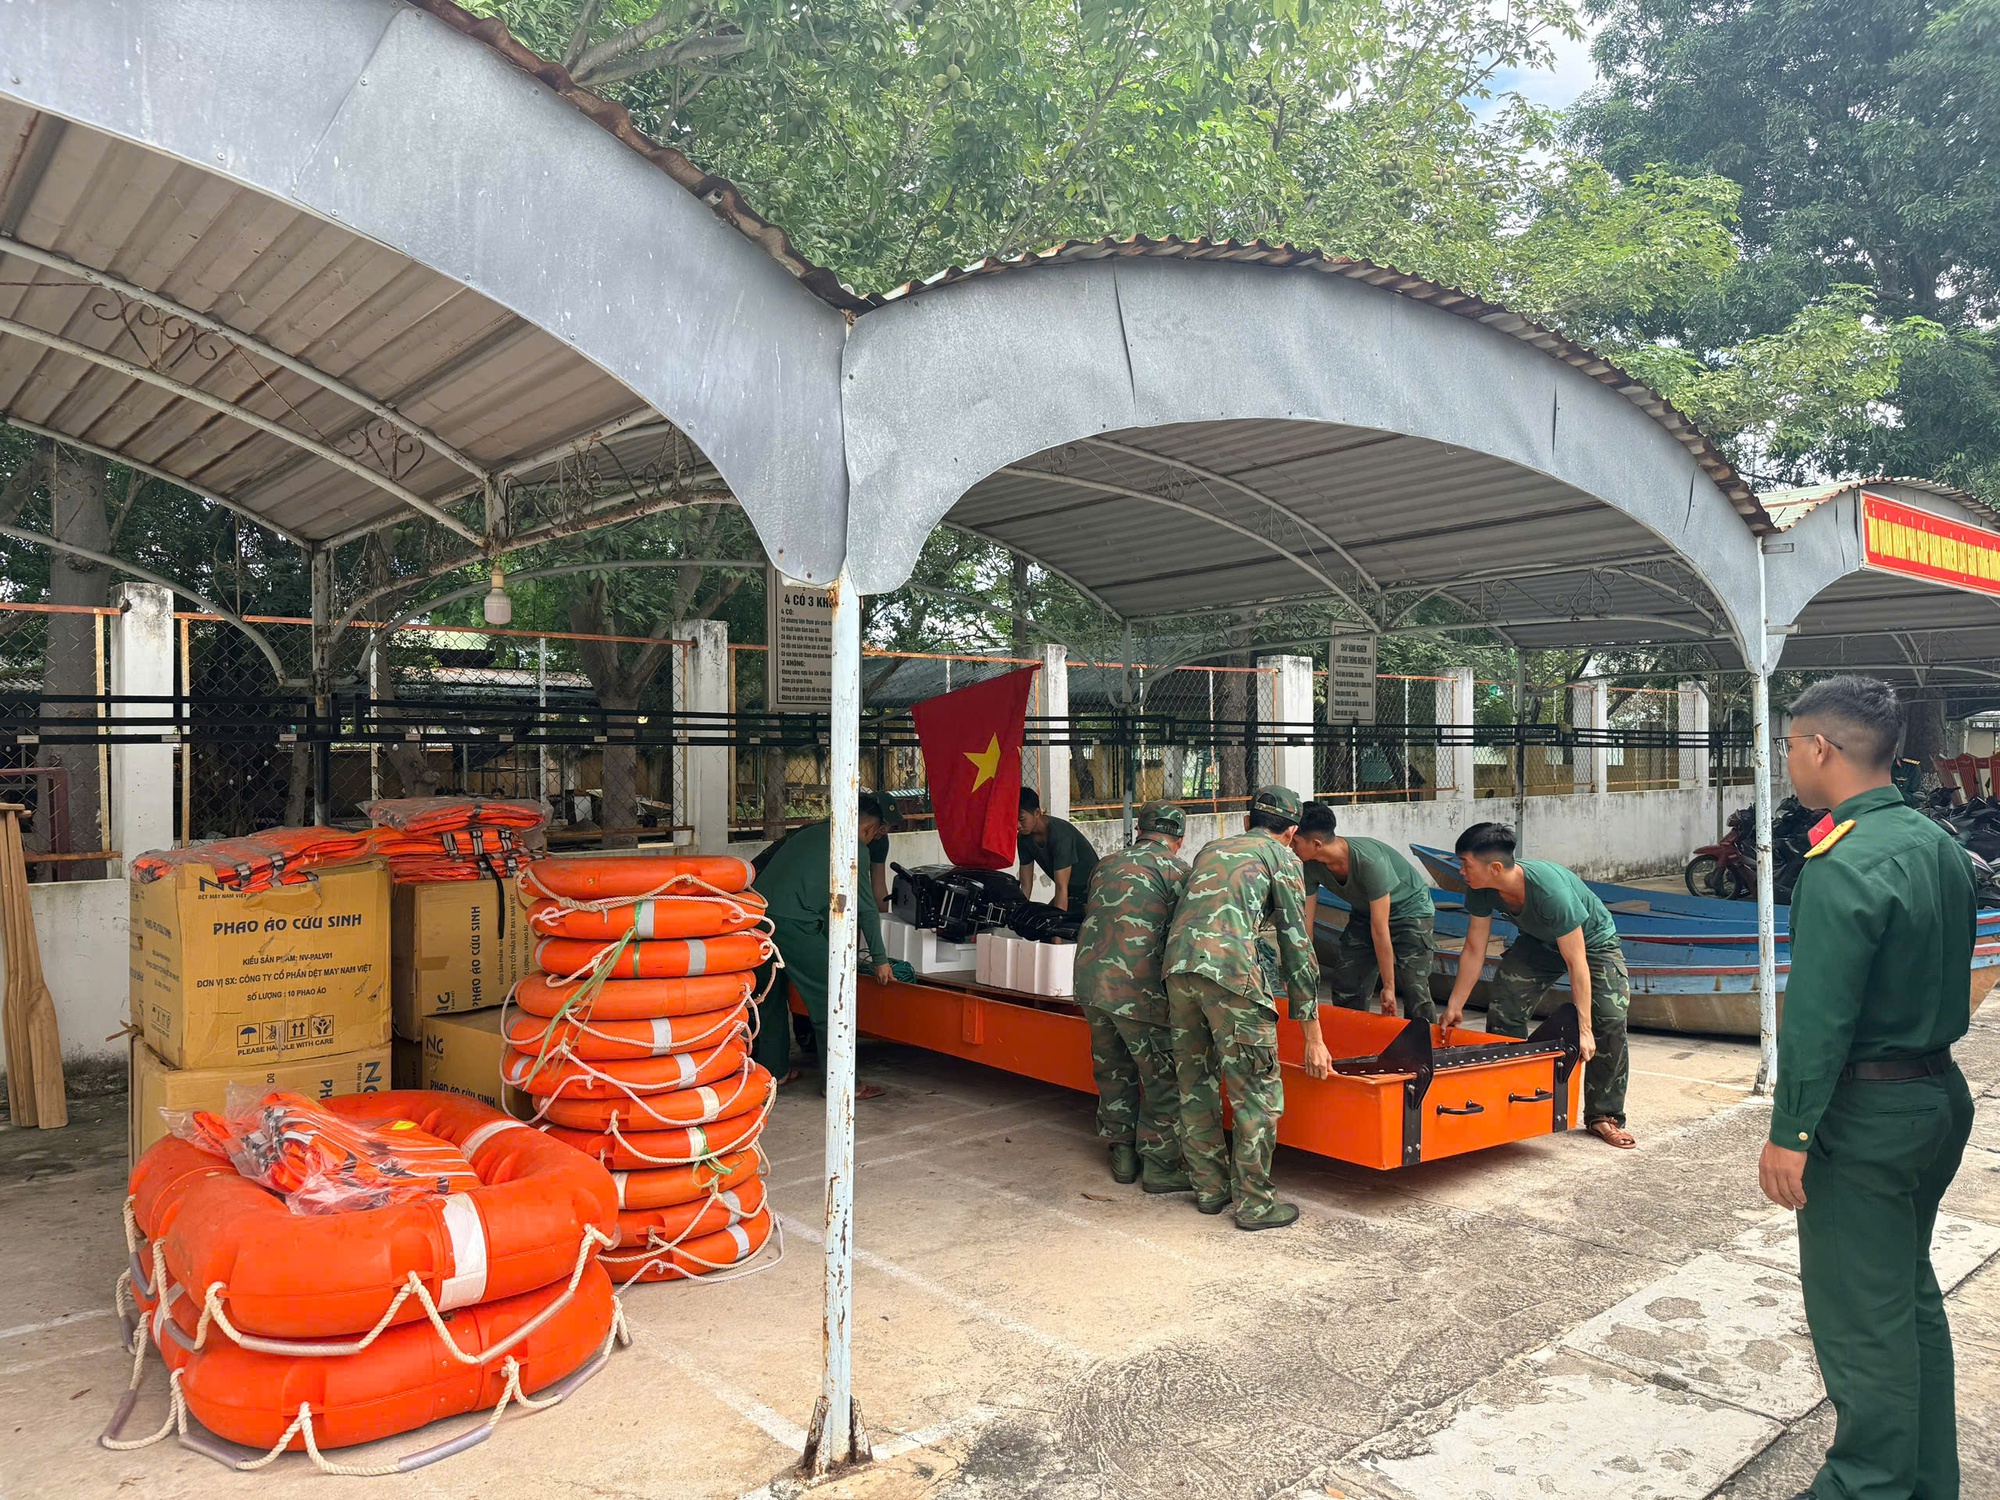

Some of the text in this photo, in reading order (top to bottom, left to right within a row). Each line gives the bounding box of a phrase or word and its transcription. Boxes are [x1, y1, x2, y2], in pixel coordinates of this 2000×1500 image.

[784, 594, 790, 605] 4
[793, 593, 806, 606] CÓ
[808, 596, 814, 606] 3
[213, 914, 362, 935] PHAO ÁO CỨU SINH
[471, 906, 481, 931] SINH
[469, 935, 481, 956] CỨU
[242, 955, 259, 966] KIỂU
[260, 955, 275, 964] SẢN
[299, 952, 333, 961] NV-PALV01
[470, 959, 482, 975] ÁO
[196, 963, 372, 988] ĐƠN VỊ SX: CÔNG TY CỔ PHẦN DỆT MAY NAM VIỆT
[247, 991, 257, 1001] SỐ
[258, 991, 282, 1000] LƯỢNG
[297, 988, 316, 997] PHAO
[316, 986, 327, 994] ÁO
[237, 1038, 334, 1056] PLEASE HADLE WITH CARE
[319, 1079, 333, 1099] PH
[430, 1080, 448, 1092] PHAO
